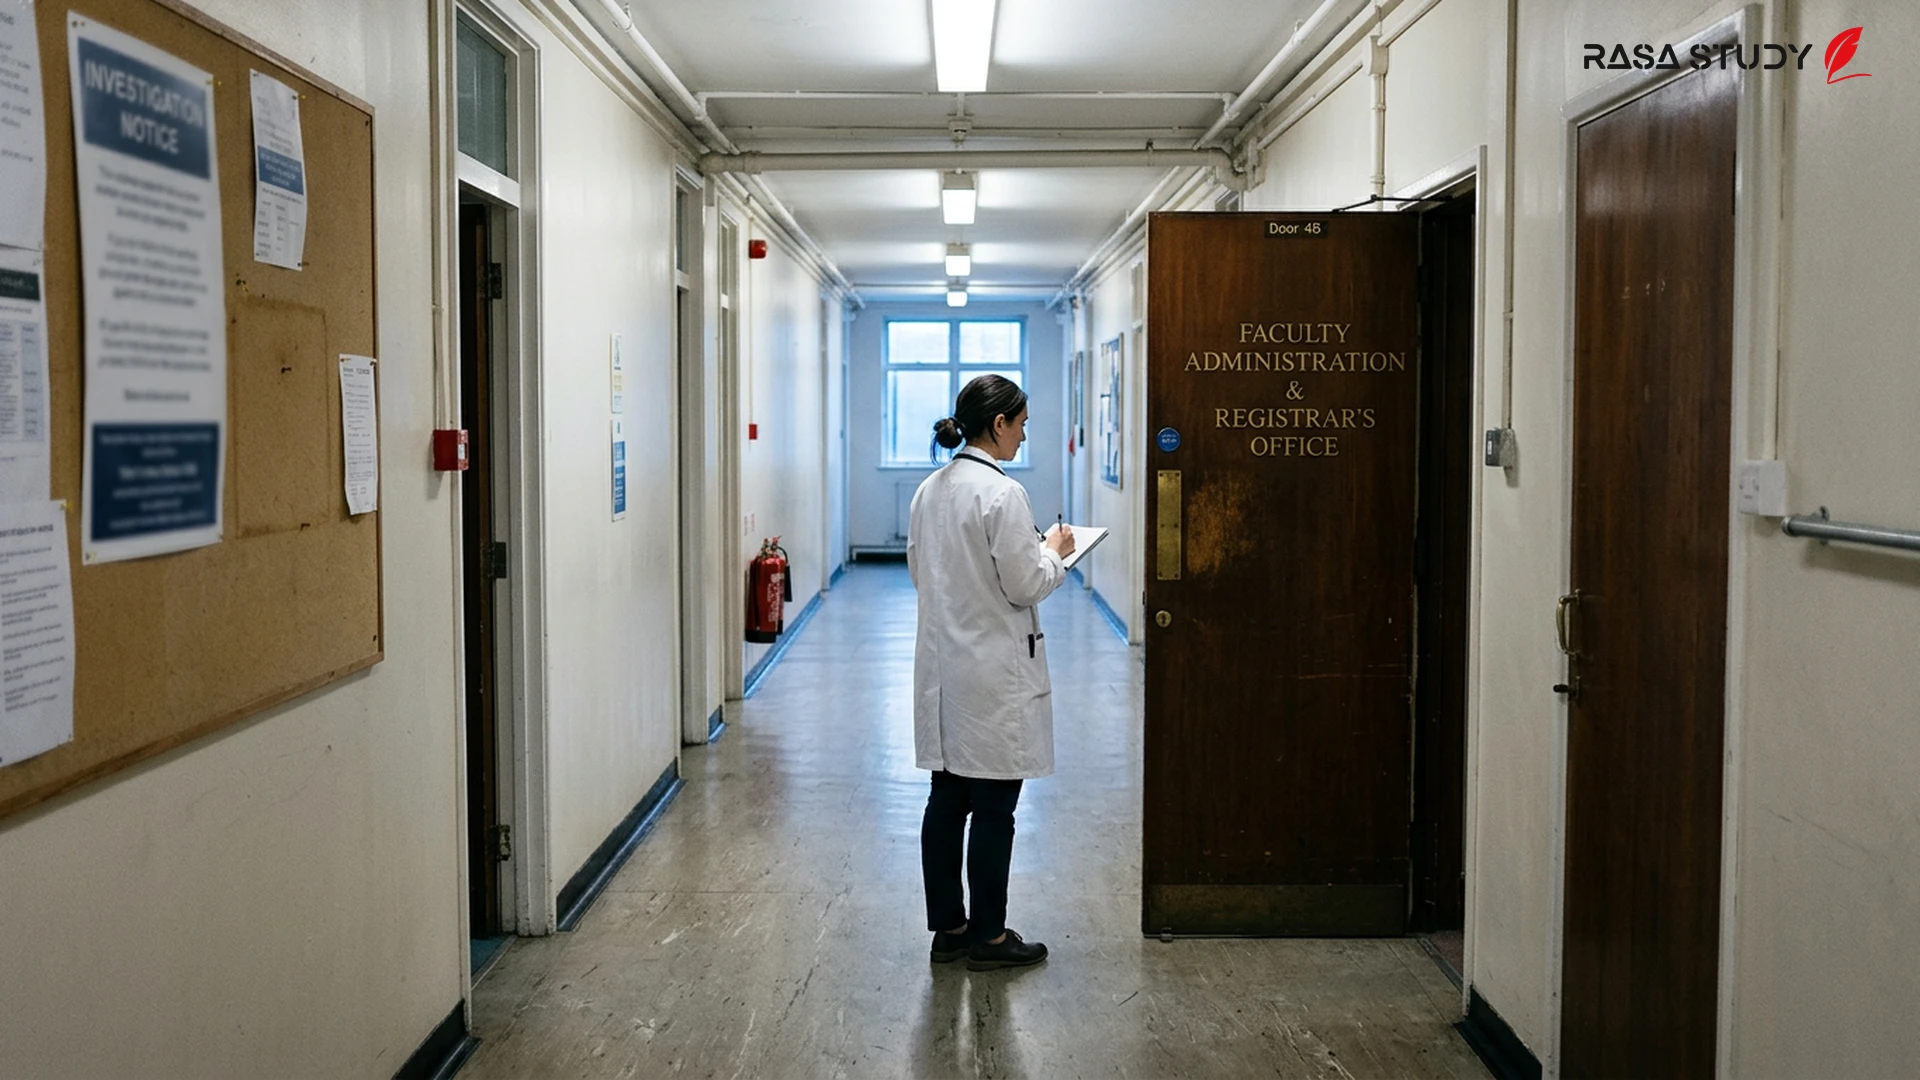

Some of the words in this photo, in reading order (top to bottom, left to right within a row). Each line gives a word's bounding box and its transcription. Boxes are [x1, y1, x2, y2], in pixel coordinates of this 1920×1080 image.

[85, 59, 205, 128] INVESTIGATION
[121, 111, 179, 155] NOTICE
[1269, 222, 1299, 234] Door
[1239, 323, 1351, 344] FACULTY
[1184, 352, 1406, 372] ADMINISTRATION
[1286, 380, 1304, 400] &
[1214, 408, 1376, 429] REGISTRAR'S
[1250, 436, 1339, 457] OFFICE
